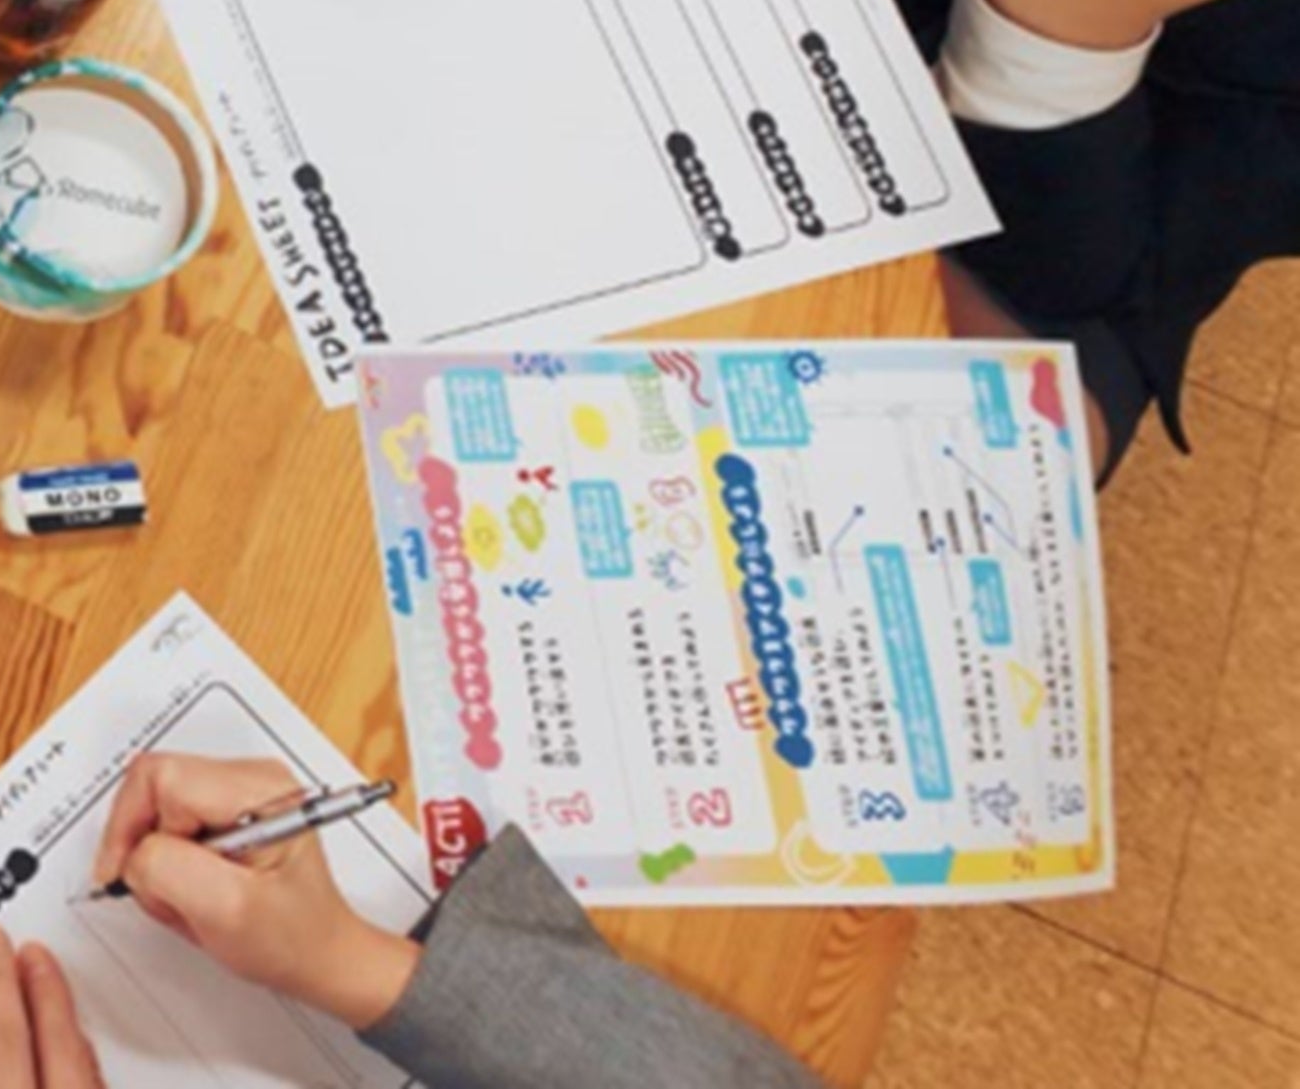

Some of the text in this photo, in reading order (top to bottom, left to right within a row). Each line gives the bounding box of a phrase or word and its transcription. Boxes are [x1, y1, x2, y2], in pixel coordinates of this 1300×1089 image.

[257, 197, 321, 288] SHEET
[296, 290, 354, 384] IDEA
[44, 486, 121, 507] MONO
